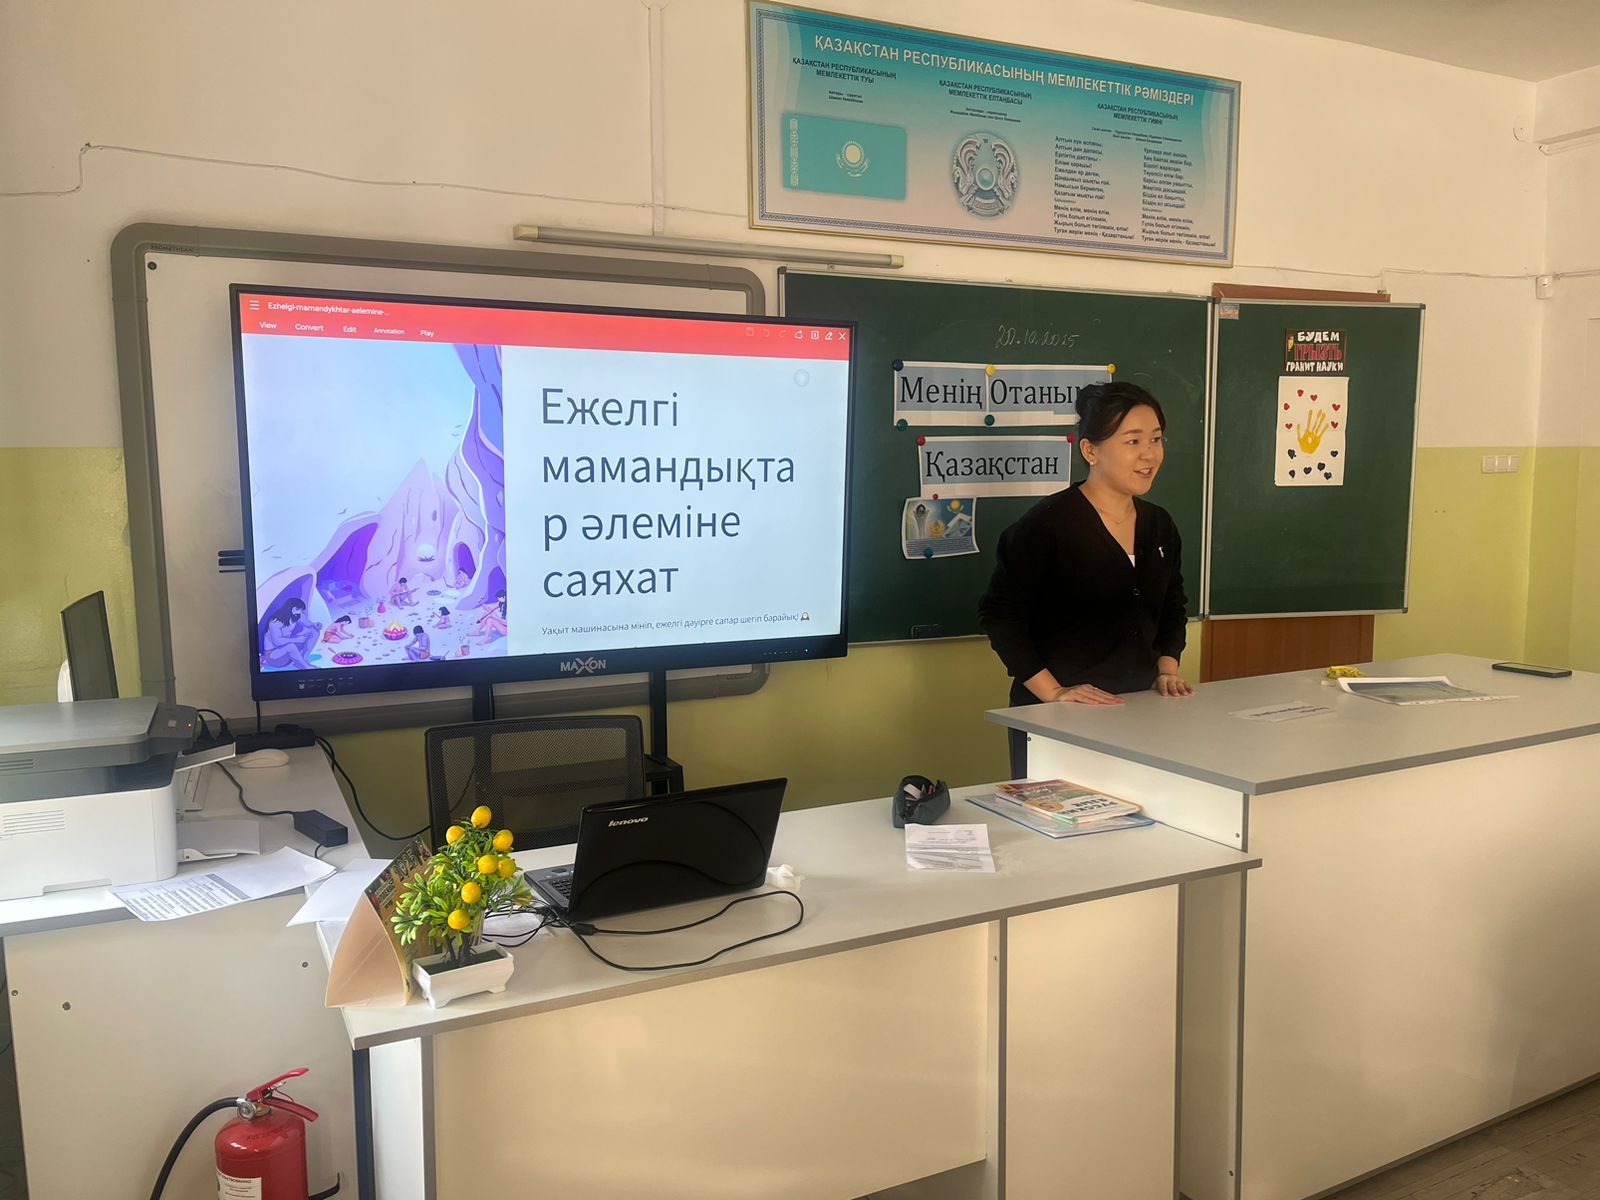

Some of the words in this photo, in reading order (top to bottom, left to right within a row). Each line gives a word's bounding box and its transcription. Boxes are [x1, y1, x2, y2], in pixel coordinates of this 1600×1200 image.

[792, 57, 830, 69] ҚАЗАҚСТАН
[831, 62, 897, 80] РЕСПУБЛИКАСЫНЫҢ
[815, 34, 899, 61] ҚАЗАҚСТАН
[903, 49, 1045, 85] РЕСПУБЛИКАСЫНЫҢ
[1048, 72, 1132, 96] МЕМЛЕКЕТТІК
[1134, 85, 1194, 106] РӘМІЗДЕРІ
[816, 69, 859, 82] МЕМЛЕКЕТТІК
[861, 75, 875, 84] ТУЫ
[939, 80, 973, 91] ҚАЗАҚСТАН
[259, 321, 277, 330] View
[295, 323, 324, 332] Convert
[343, 325, 357, 333] Edit
[420, 329, 435, 338] Play
[1297, 331, 1340, 343] БУДЕМ
[1286, 361, 1315, 372] ГРАНИТ
[1316, 361, 1344, 372] НАУКИ
[900, 376, 983, 410] Менің
[990, 379, 1080, 405] Отаны
[542, 387, 678, 427] Ежелгі
[542, 455, 795, 491] мамандықта
[925, 451, 1059, 482] Қазақстан
[543, 512, 568, 551] р
[581, 504, 741, 540] әлеміне
[542, 566, 679, 599] саяхат
[541, 626, 569, 636] Уақыт
[571, 623, 629, 633] машинасына
[715, 616, 739, 626] сапар
[560, 657, 607, 674] MAXON
[608, 816, 649, 827] lenovo
